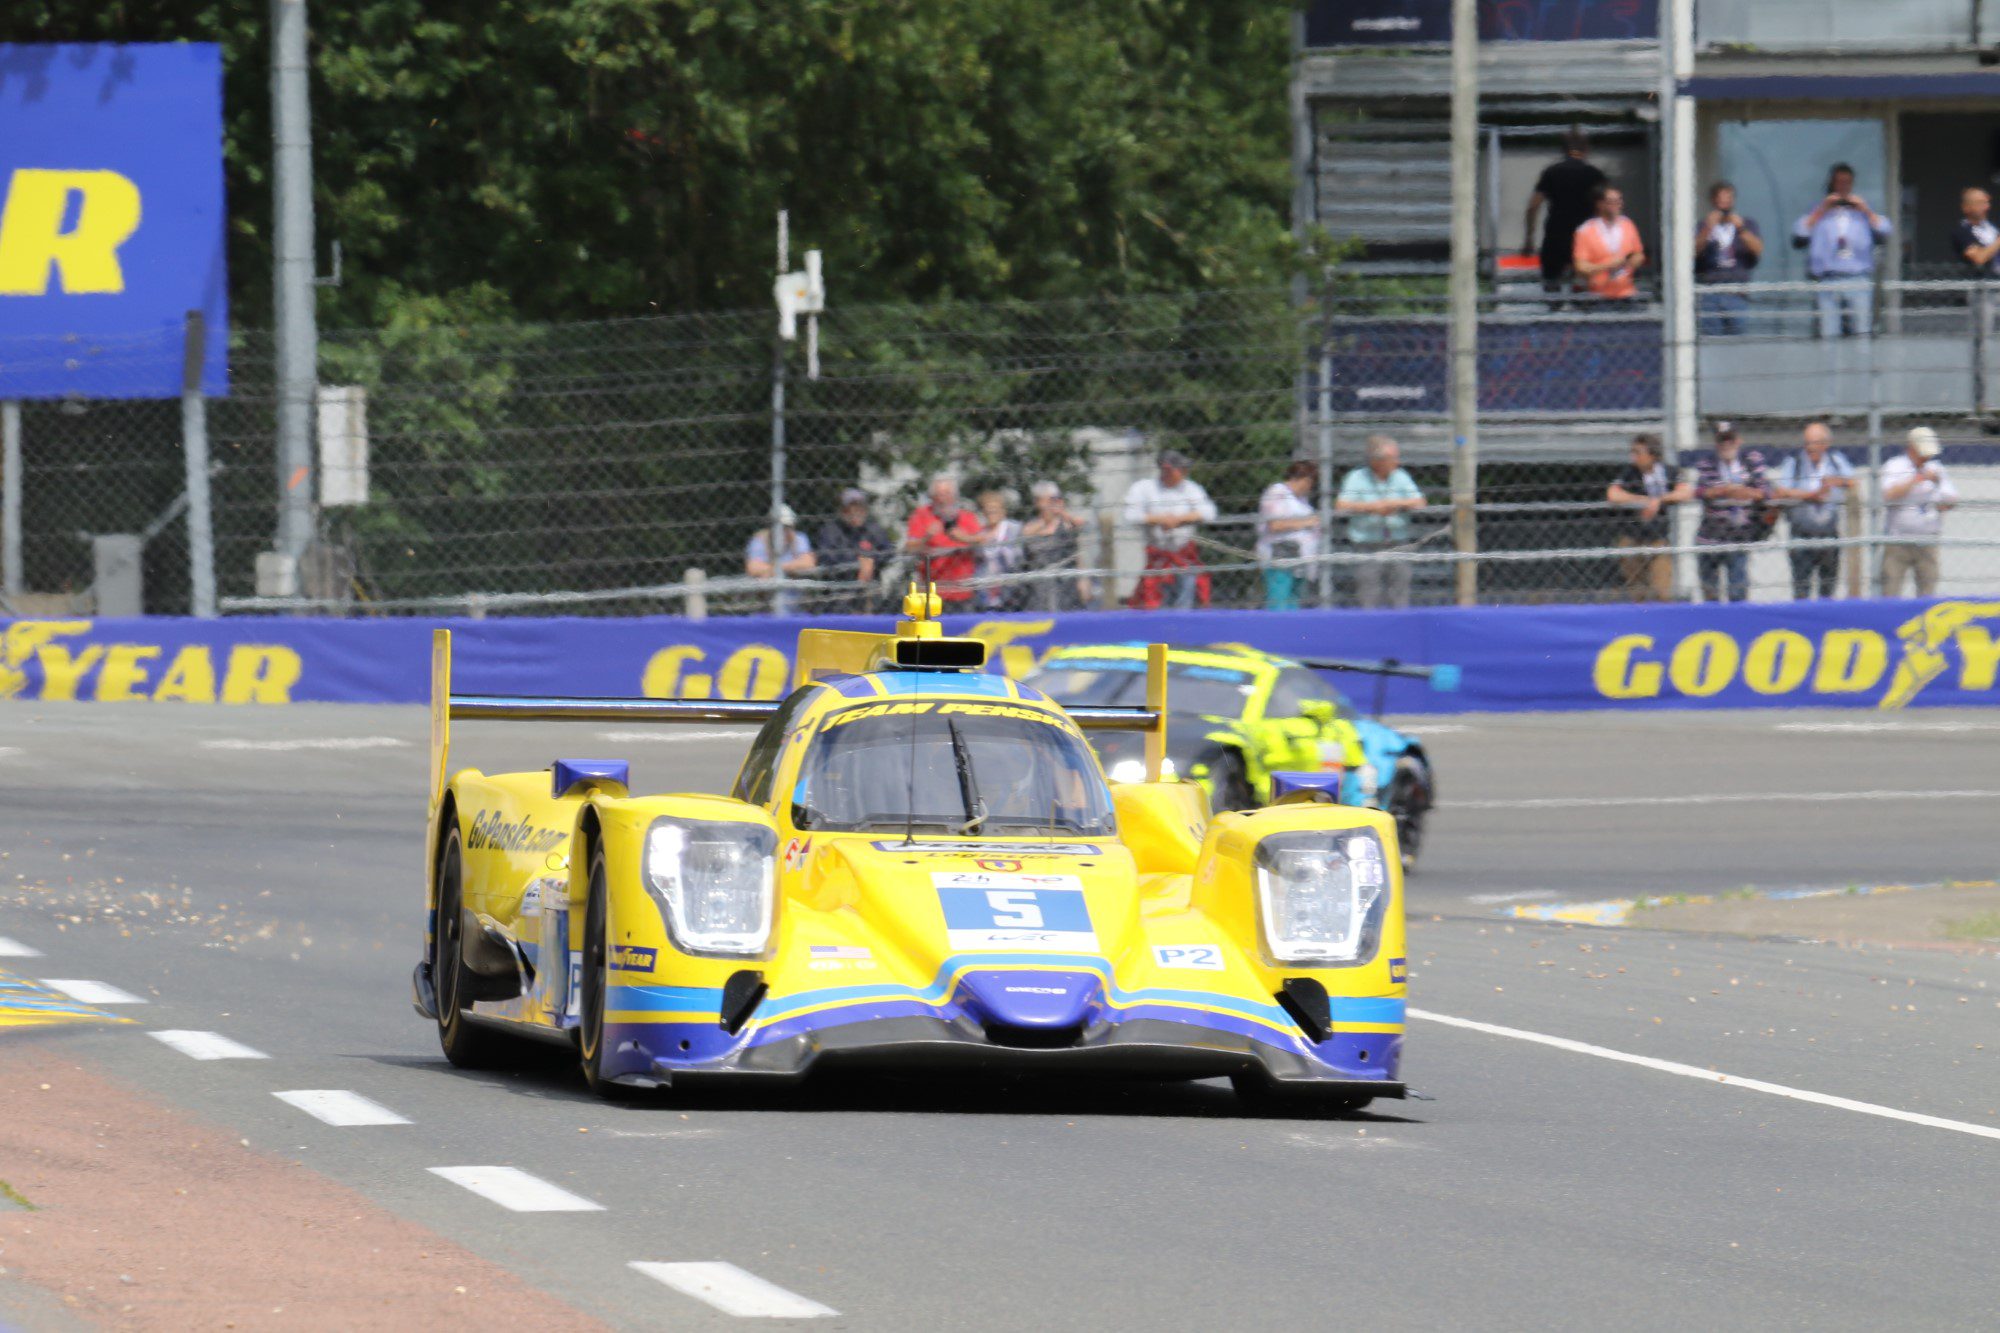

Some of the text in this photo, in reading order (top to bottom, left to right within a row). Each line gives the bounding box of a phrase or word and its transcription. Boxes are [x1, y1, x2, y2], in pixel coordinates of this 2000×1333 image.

[820, 702, 936, 733] TEAM
[467, 809, 570, 851] GoPenske.com
[985, 890, 1045, 928] 5
[1159, 947, 1217, 965] P2
